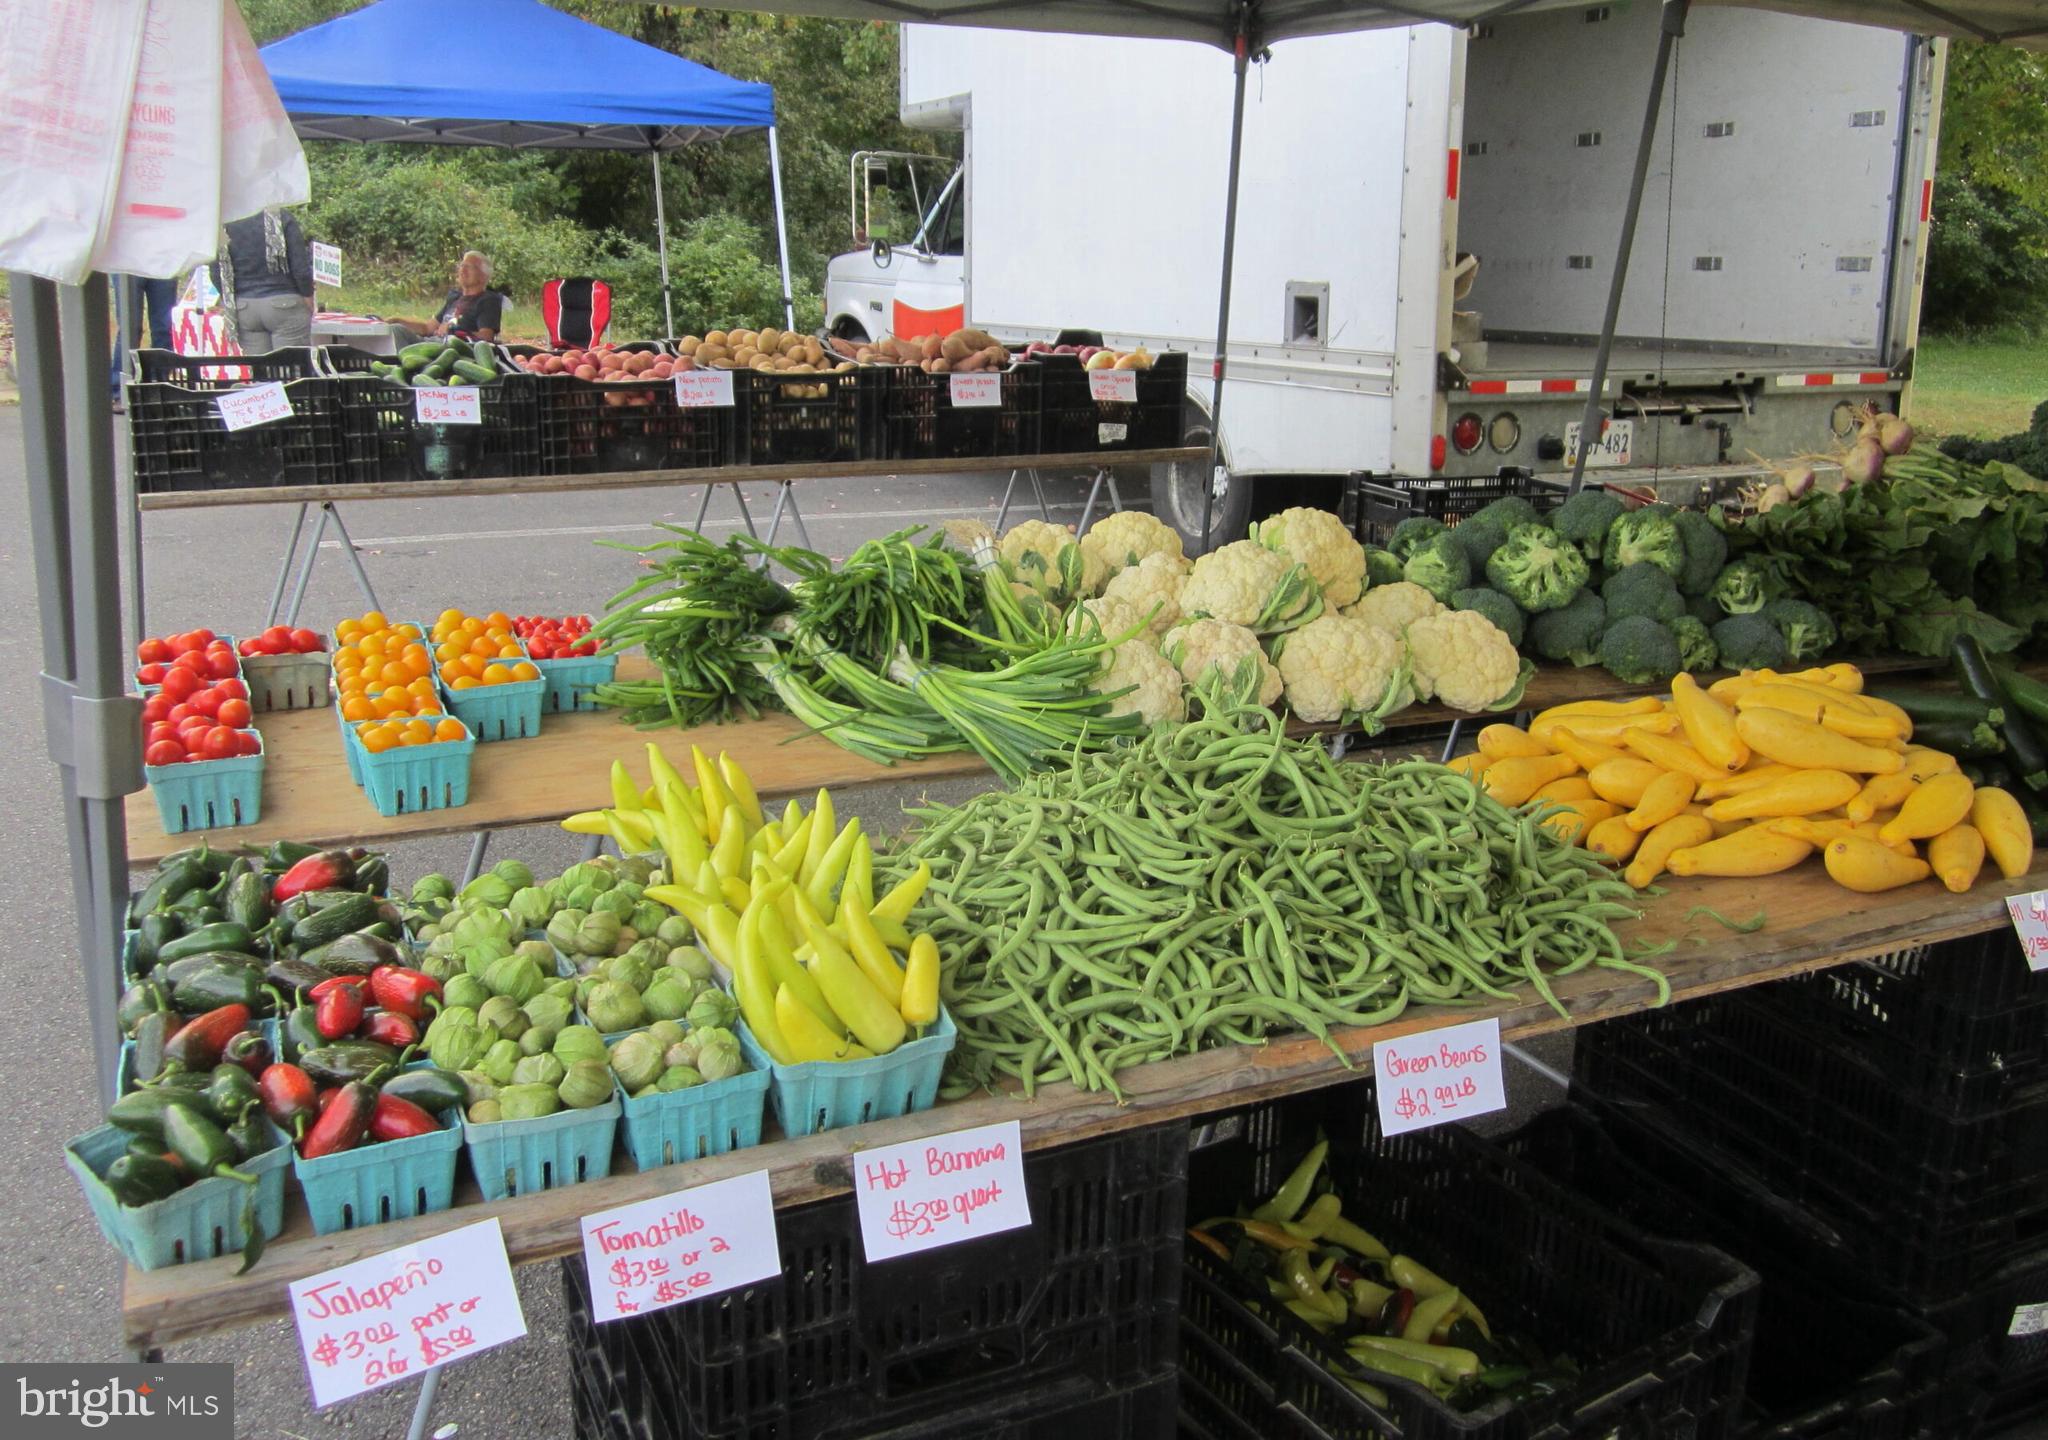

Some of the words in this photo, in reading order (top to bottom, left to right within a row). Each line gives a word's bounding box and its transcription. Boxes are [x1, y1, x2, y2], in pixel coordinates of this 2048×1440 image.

[315, 258, 324, 272] NO
[324, 261, 340, 276] DOGS
[222, 388, 276, 409] Cucumbers
[1605, 433, 1629, 454] 482
[1386, 1049, 1437, 1077] Green
[1440, 1043, 1487, 1068] Beans
[1395, 1086, 1457, 1119] $2.99
[1455, 1077, 1476, 1098] LB
[866, 1158, 911, 1190] Hot
[953, 1180, 1002, 1224] quart
[590, 1208, 704, 1255] Tomatillo
[681, 1250, 702, 1266] or
[709, 1237, 731, 1253] 2
[302, 1258, 442, 1319] Jalapeño
[616, 1291, 640, 1313] for
[459, 1296, 481, 1314] or
[364, 1359, 387, 1386] 2
[386, 1347, 408, 1374] for
